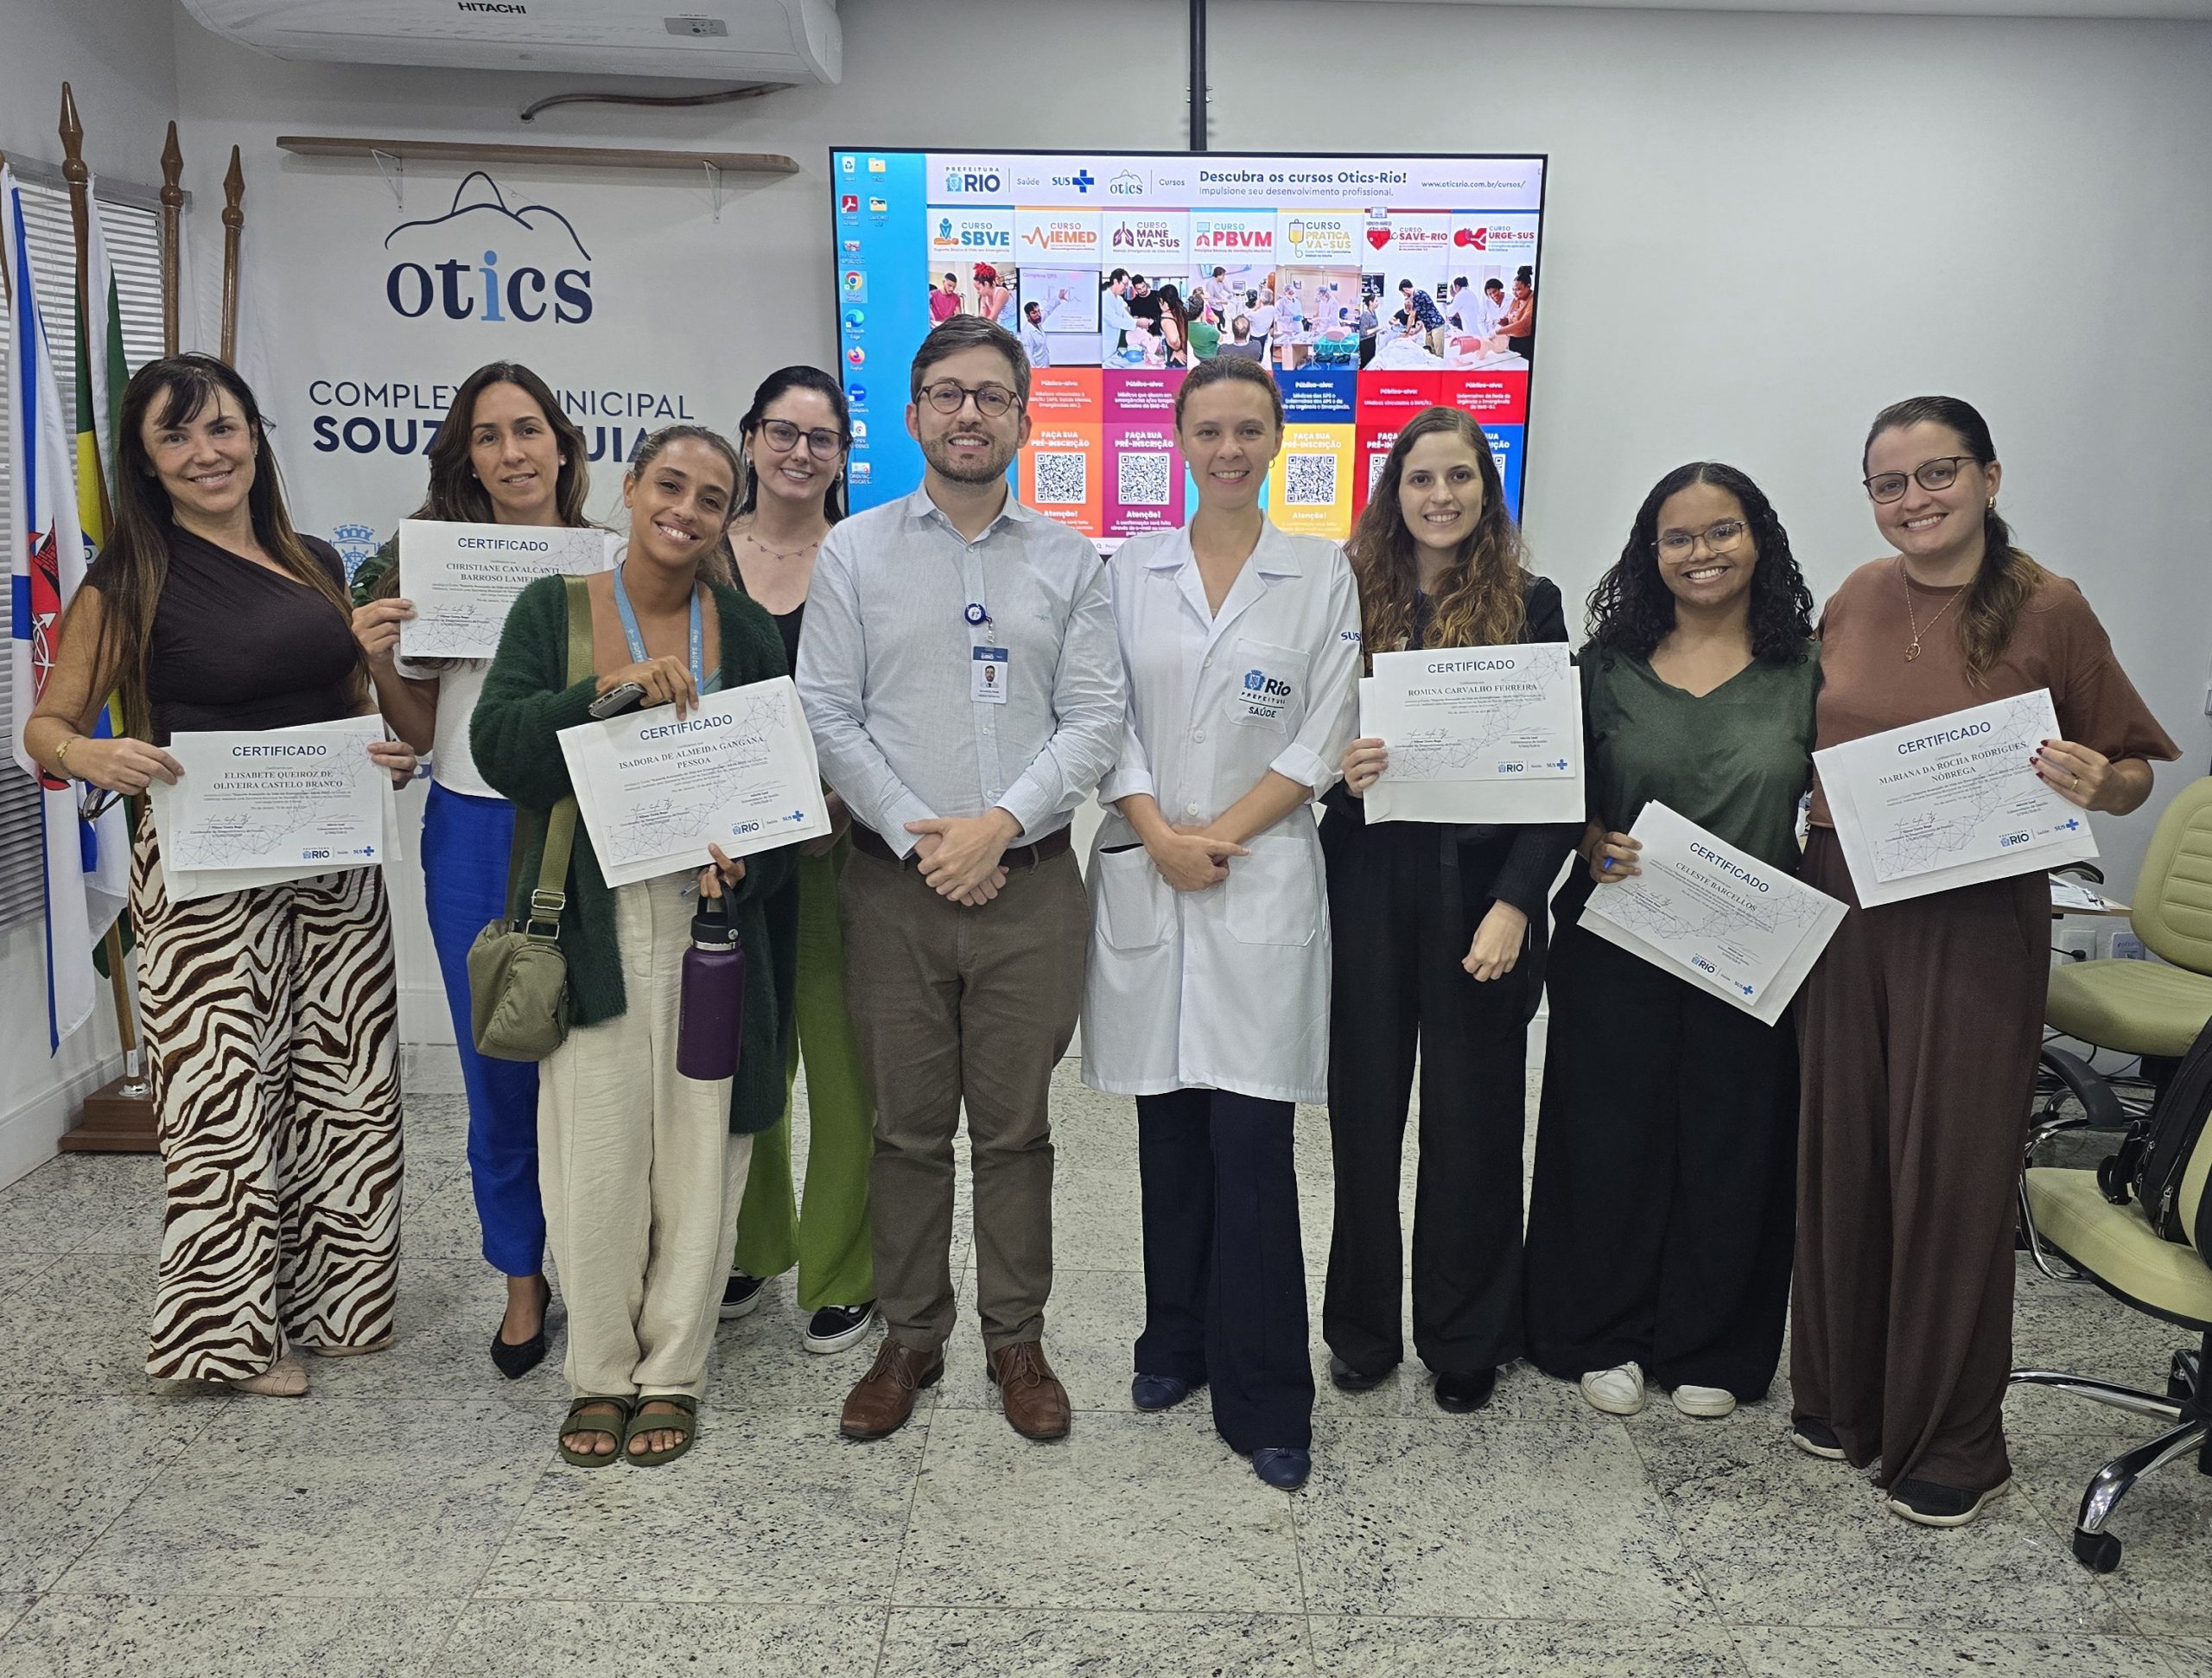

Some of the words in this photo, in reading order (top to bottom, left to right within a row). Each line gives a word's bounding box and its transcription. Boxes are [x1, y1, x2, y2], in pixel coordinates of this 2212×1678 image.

[458, 1, 527, 15] HITACHI
[1017, 177, 1040, 186] Saúde
[1052, 176, 1071, 186] SUS
[1159, 178, 1185, 187] Cursos
[1199, 169, 1264, 183] Descubra
[1268, 173, 1284, 183] os
[1288, 173, 1333, 183] cursos
[1338, 171, 1407, 184] Otics-Rio!
[964, 174, 1001, 193] RIO
[1109, 181, 1143, 195] otics
[1199, 186, 1246, 196] Impulsione
[1265, 187, 1340, 197] desenvolvimento
[1342, 188, 1395, 198] profissional.
[961, 221, 993, 230] CURSO
[1136, 221, 1167, 230] CURSO
[1213, 222, 1245, 231] CURSO
[1306, 221, 1341, 230] CURSO
[961, 230, 1010, 246] SBVE
[1050, 230, 1097, 244] IEMED
[1136, 229, 1169, 238] MANE
[1212, 230, 1273, 247] PBVM
[1306, 231, 1351, 240] PRATICA
[1399, 232, 1448, 241] SAVE-RIO
[1488, 231, 1535, 239] URGE-SUS
[1136, 238, 1180, 248] VA-SUS
[1306, 240, 1351, 249] VA-SUS
[386, 250, 593, 324] otics
[309, 380, 459, 410] COMPLE
[556, 389, 695, 420] NICIPAL
[313, 415, 445, 456] SOUZ
[1125, 431, 1146, 440] FAÇA
[1294, 432, 1315, 441] FAÇA
[1377, 432, 1398, 442] FAÇA
[1031, 438, 1090, 448] PRÉ-INSCRIÇÃO
[1115, 439, 1174, 449] PRÉ-INSCRIÇÃO
[1043, 509, 1078, 519] Atenção!
[1126, 511, 1161, 520] Atenção!
[458, 537, 549, 552] CERTIFICADO
[446, 563, 501, 573] CHRISTIANE
[461, 573, 504, 582] BARROSO
[1340, 631, 1361, 641] SUS
[1427, 659, 1516, 674] CERTIFICADO
[1264, 678, 1292, 696] Rio
[1408, 688, 1443, 697] ROMINA
[1444, 685, 1493, 696] CARVALHO
[1494, 683, 1538, 693] FERREIRA
[1248, 706, 1277, 718] SAÚDE
[639, 714, 733, 741] CERTIFICADO
[1897, 721, 1992, 755] CERTIFICADO
[232, 745, 327, 757] CERTIFICADO
[619, 755, 660, 771] ISADORA
[661, 751, 675, 762] DE
[676, 743, 718, 760] ALMEIDA
[677, 757, 712, 769] PESSOA
[1506, 764, 1524, 772] RIO
[1878, 766, 1922, 786] MARIANA
[1923, 762, 1936, 774] DA
[1936, 756, 1970, 772] ROCHA
[1971, 740, 2027, 762] RODRIGUES
[224, 771, 276, 779] ELISABETE
[277, 770, 319, 780] QUEIROZ
[320, 770, 334, 779] DE
[1931, 766, 1977, 783] NÓBREGA
[213, 781, 259, 790] OLIVEIRA
[260, 780, 303, 789] CASTELO
[305, 779, 343, 788] BRANCO
[741, 822, 760, 835] RIO
[2009, 832, 2030, 846] RIO
[311, 849, 330, 860] RIO
[1689, 841, 1770, 893] CERTIFICADO
[1675, 861, 1711, 886] CELESTE
[1710, 880, 1758, 912] BARCELLOS
[1698, 959, 1715, 975] RIO
